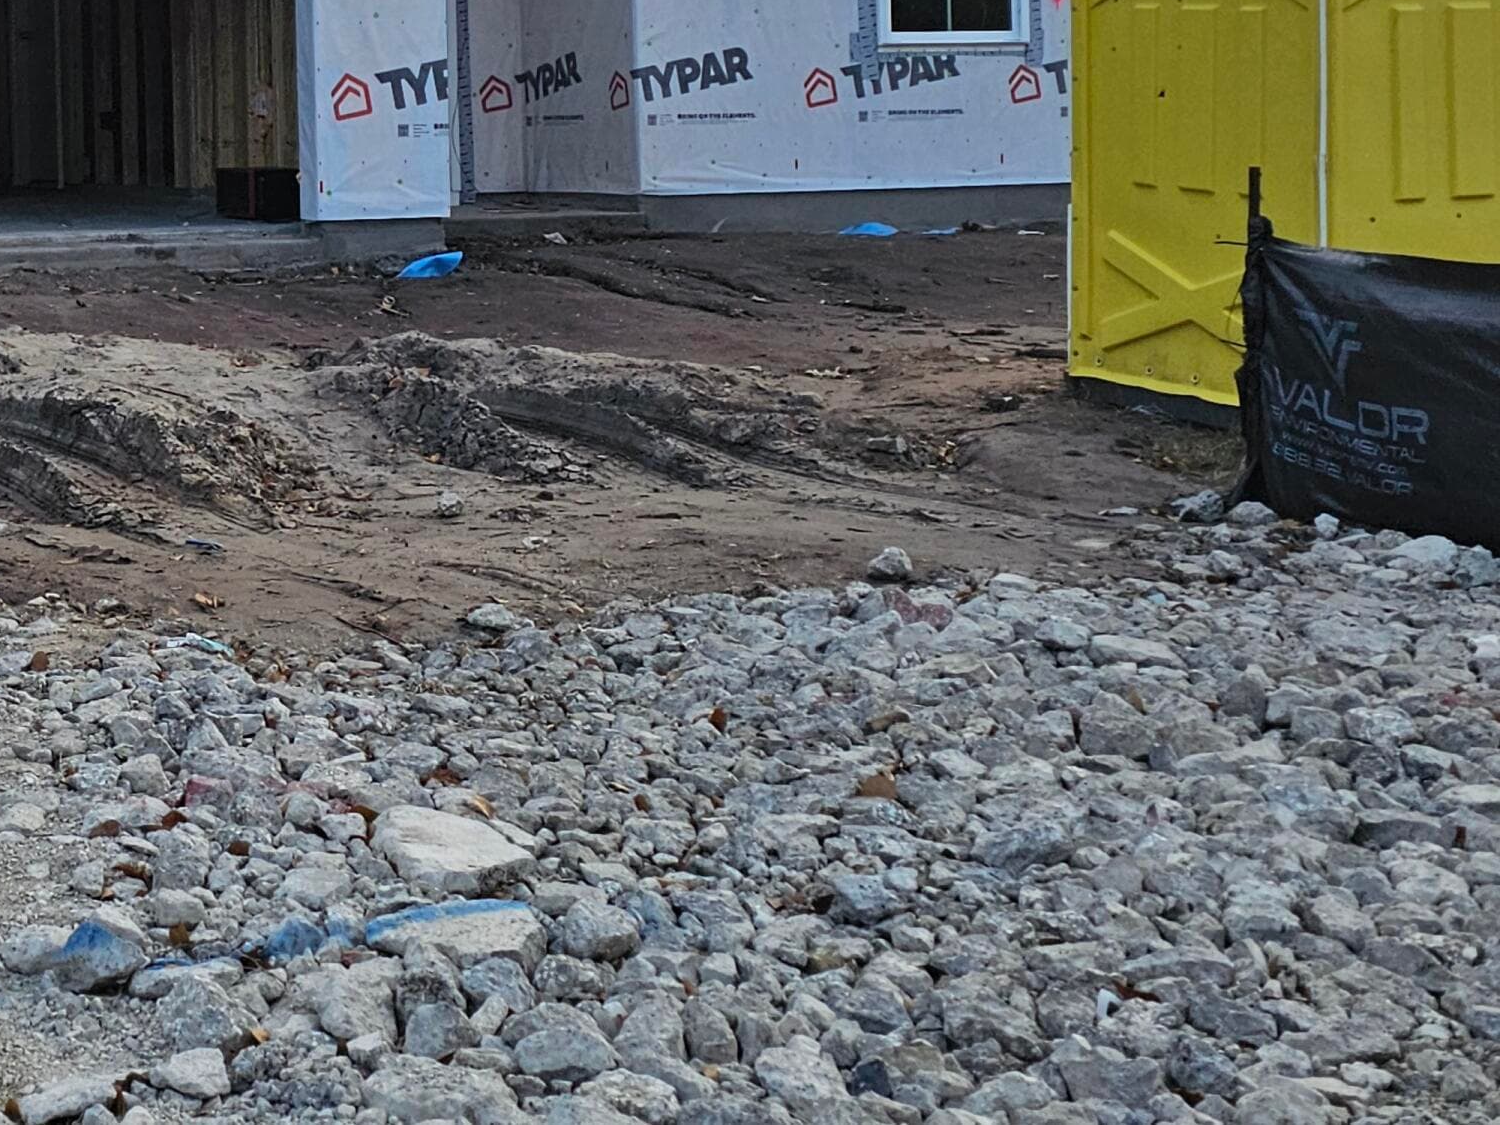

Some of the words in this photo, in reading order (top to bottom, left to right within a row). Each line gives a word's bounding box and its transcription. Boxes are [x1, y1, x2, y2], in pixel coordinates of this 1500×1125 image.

[514, 51, 582, 104] TYPAR
[629, 47, 753, 102] TYPAR
[1273, 366, 1429, 445] VALOR
